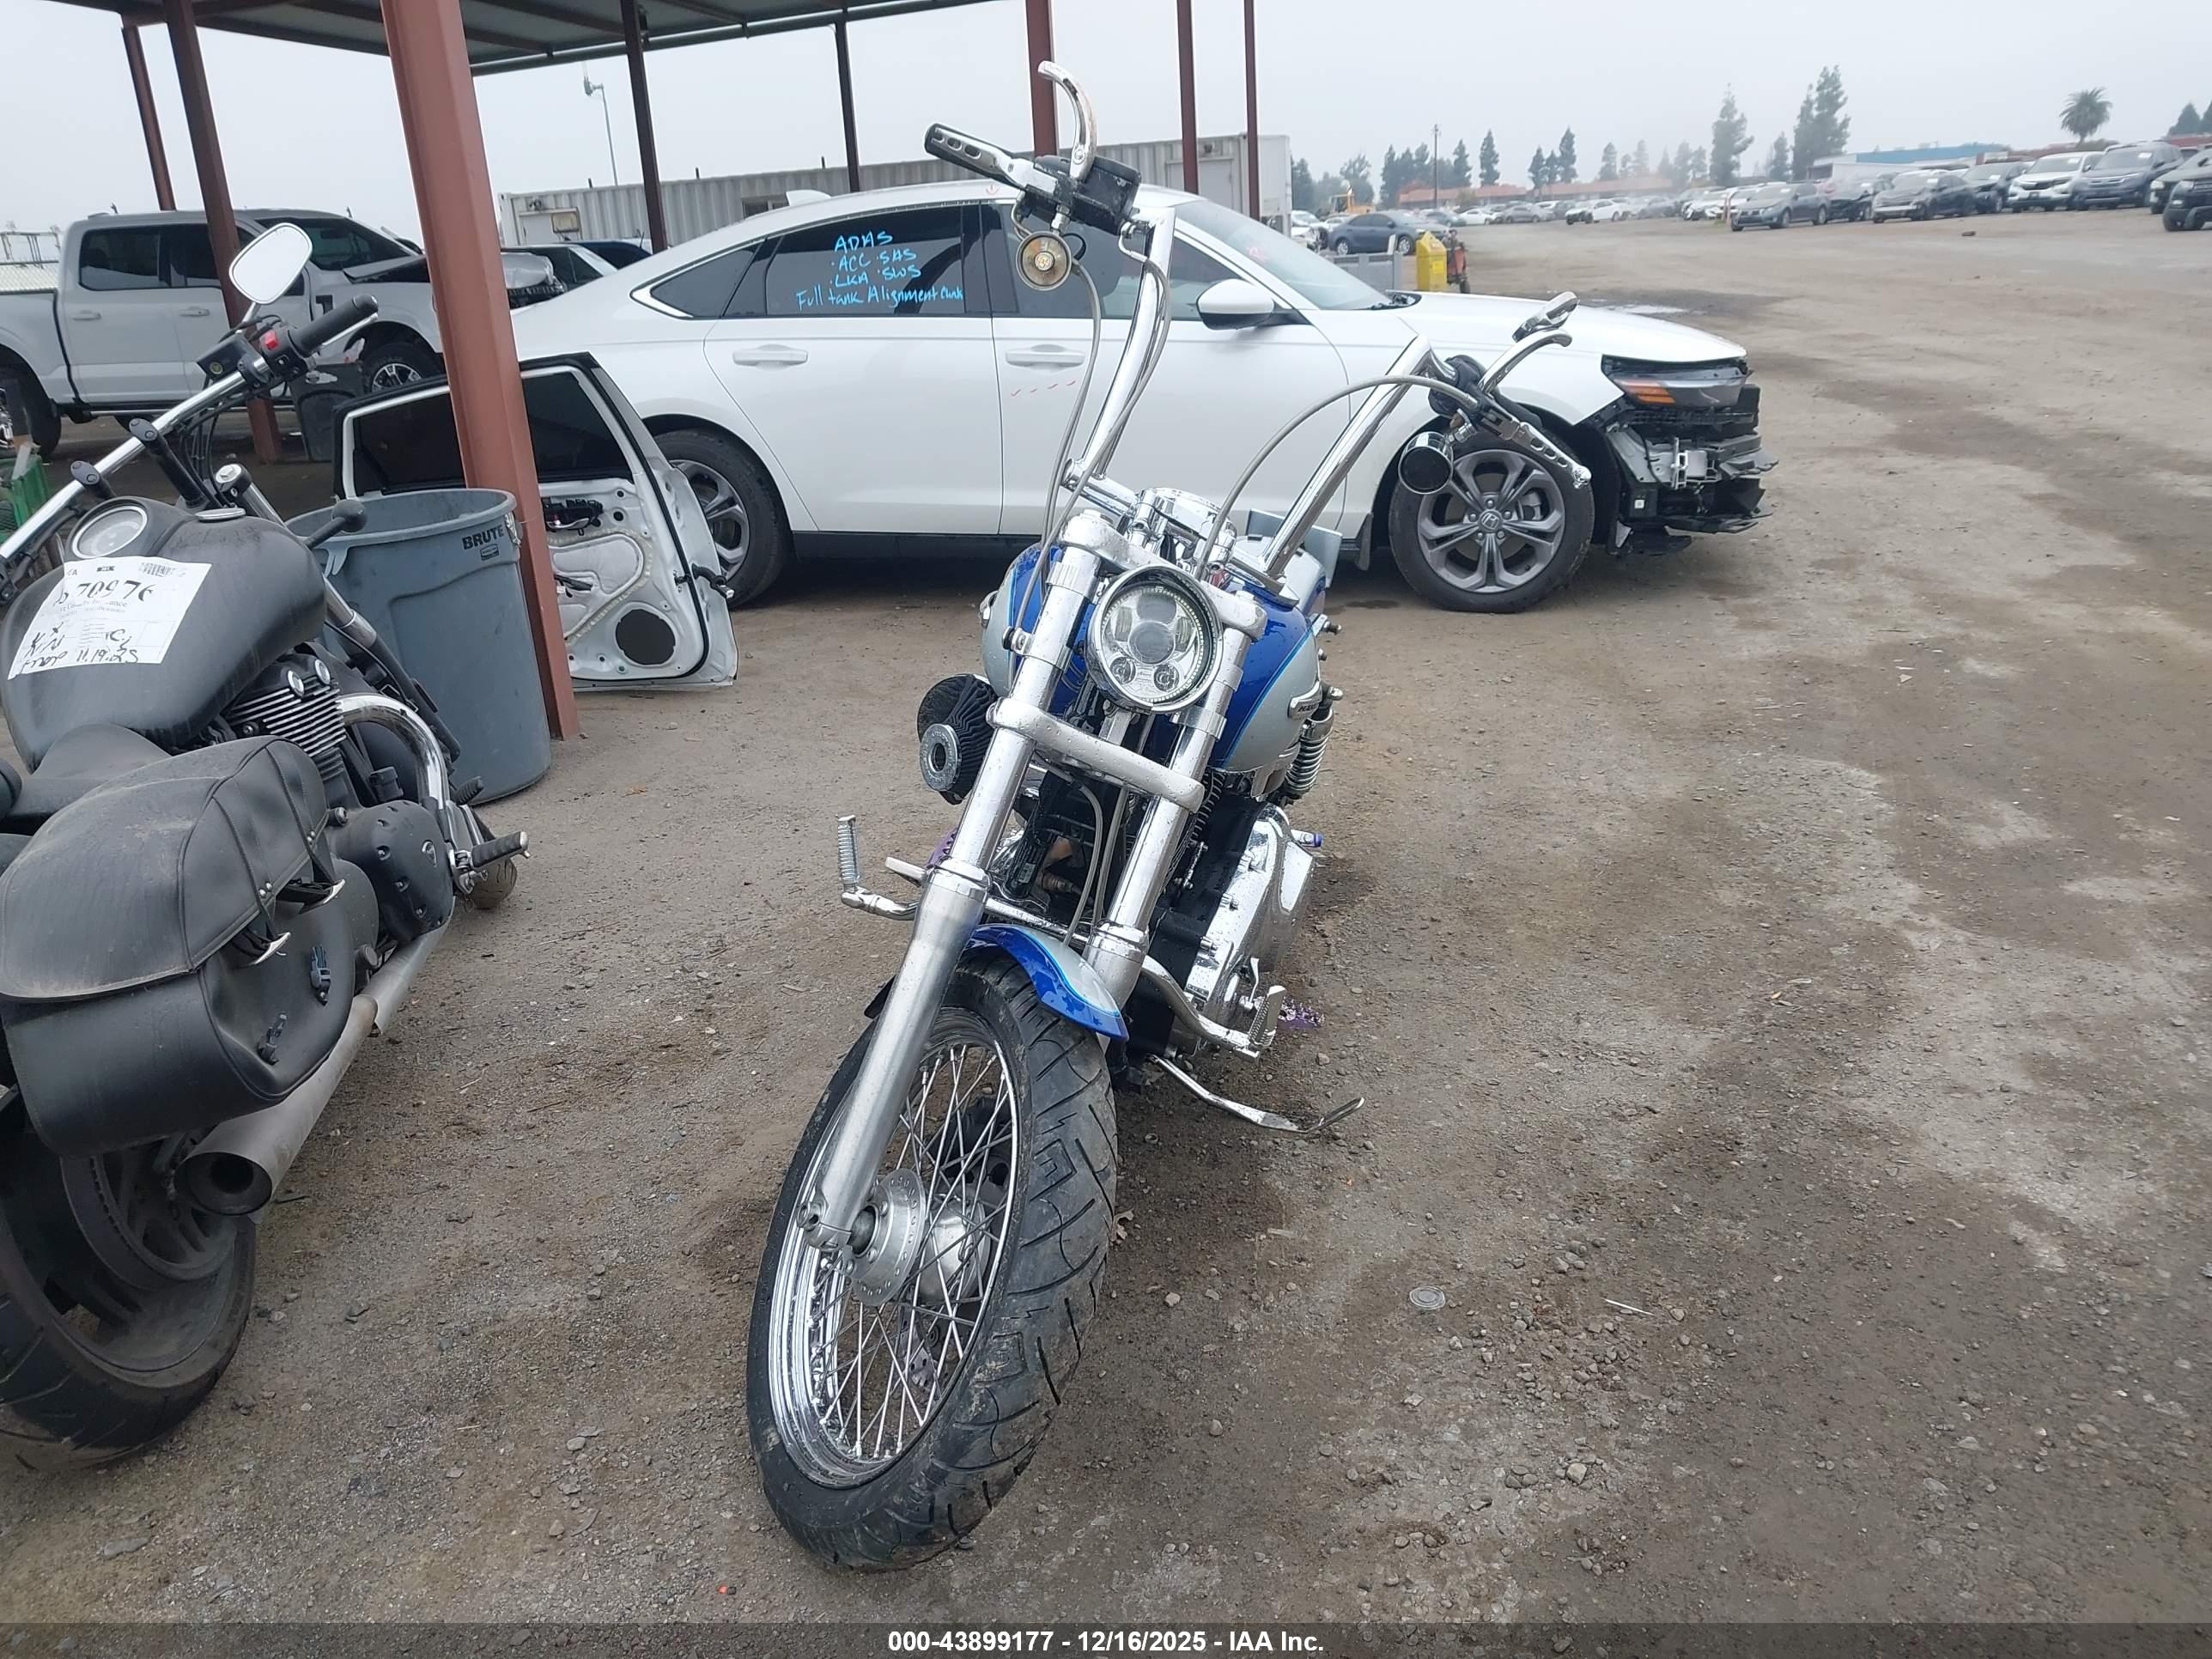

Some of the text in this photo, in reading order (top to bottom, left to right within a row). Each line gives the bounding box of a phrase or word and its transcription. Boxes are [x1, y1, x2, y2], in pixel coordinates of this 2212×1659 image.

[796, 283, 824, 312] Full
[867, 285, 939, 309] Alignment
[462, 524, 504, 550] BRUTE
